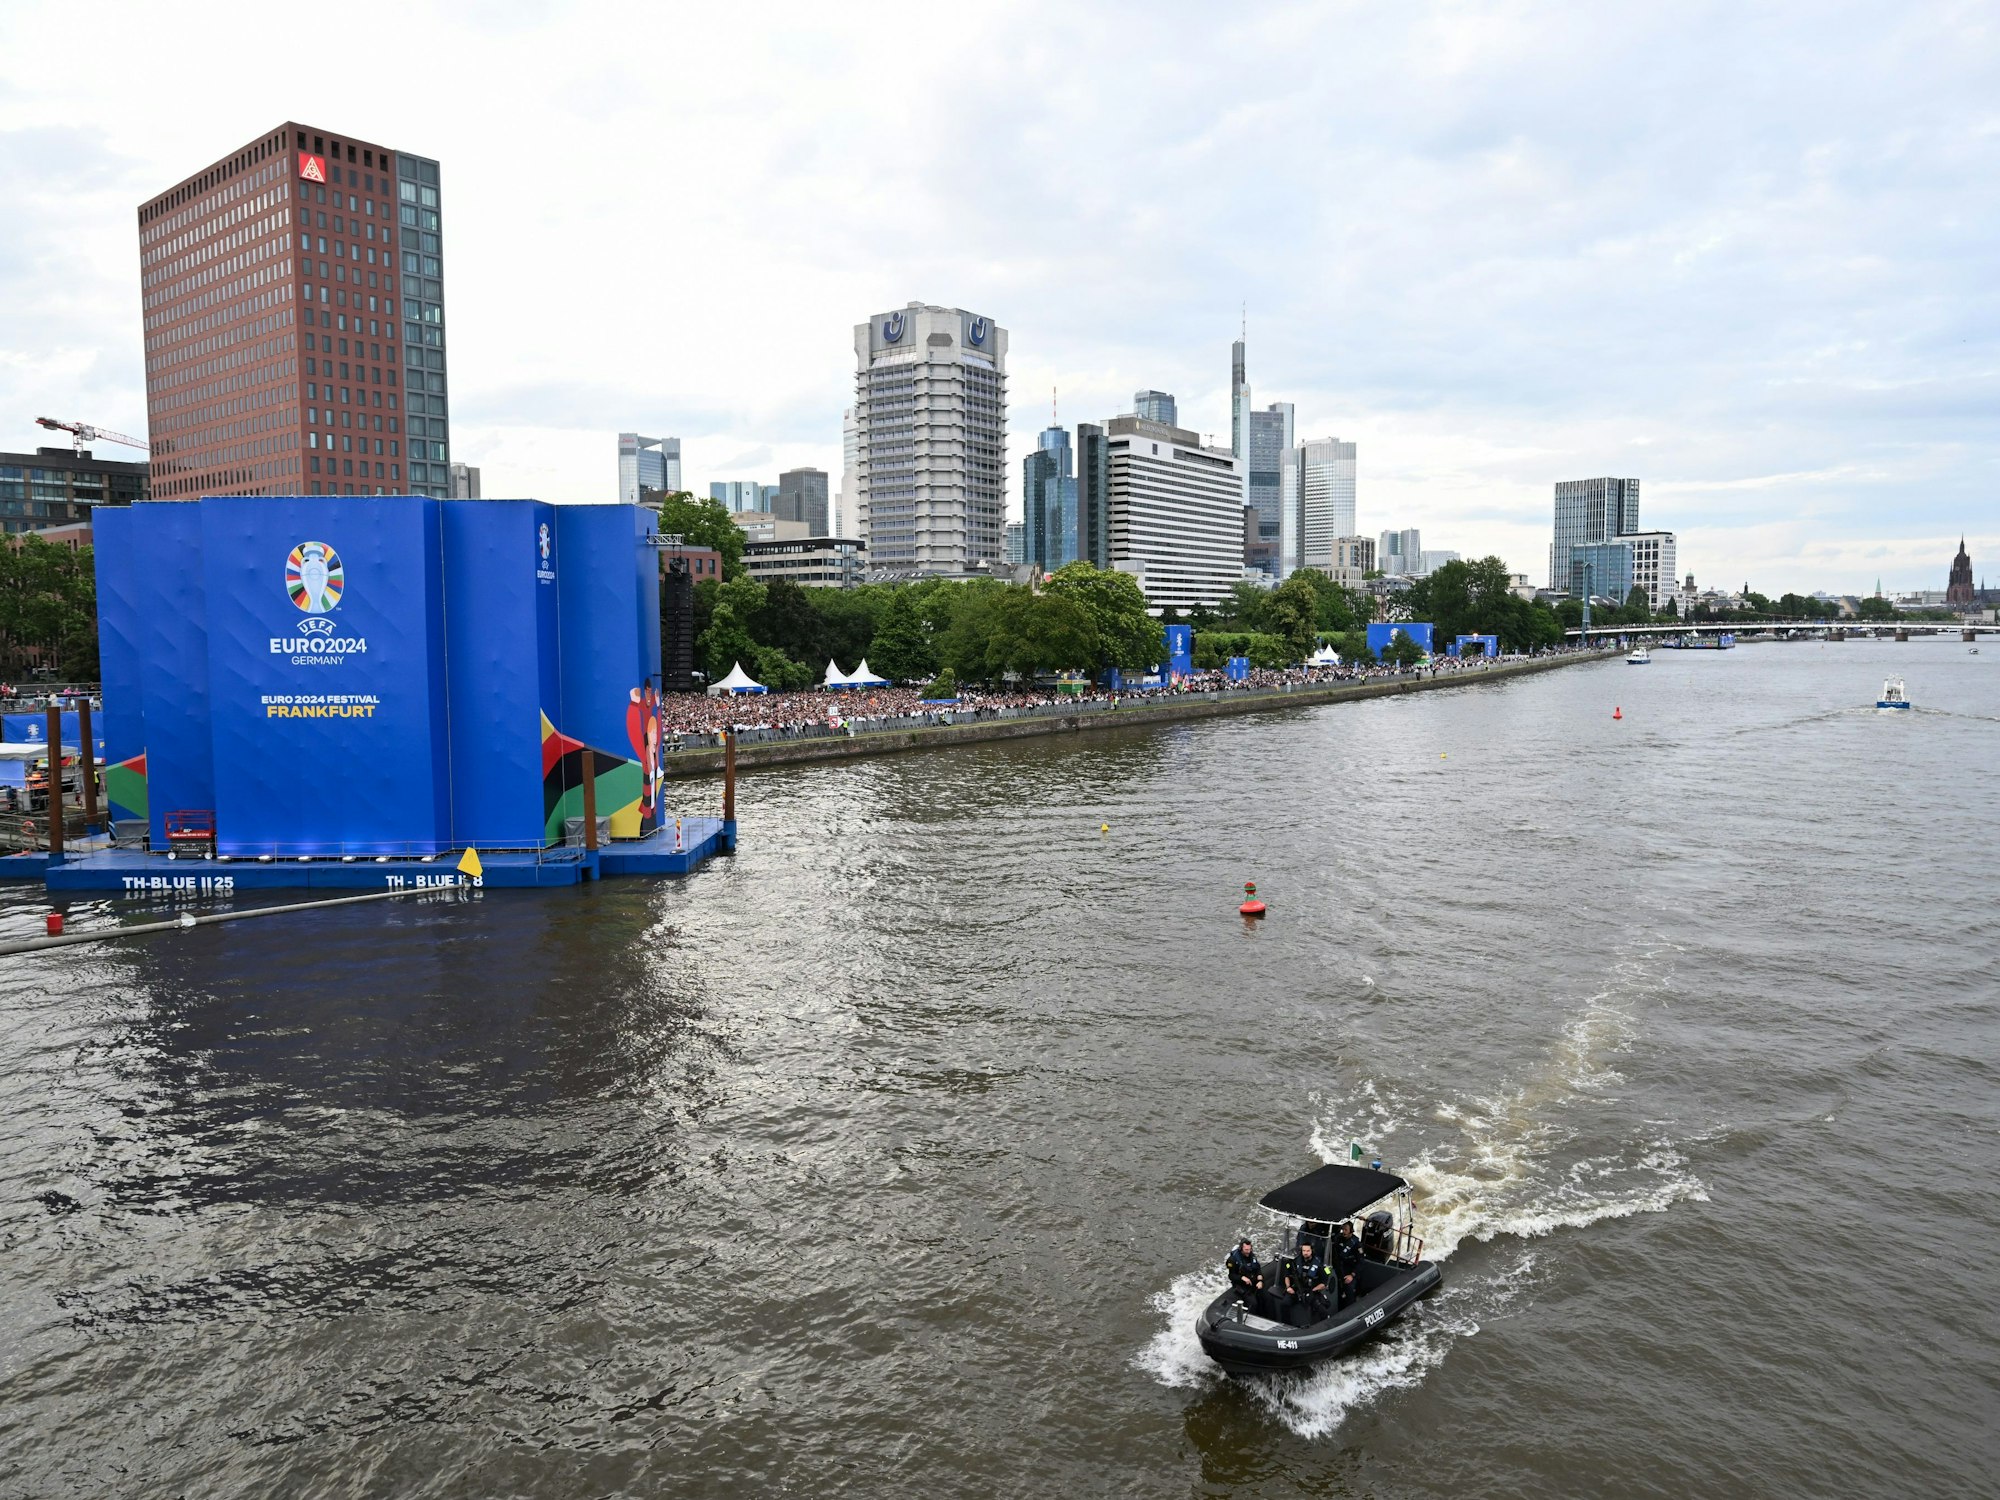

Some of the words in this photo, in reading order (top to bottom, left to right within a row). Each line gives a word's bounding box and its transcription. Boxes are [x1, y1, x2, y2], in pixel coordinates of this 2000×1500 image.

[299, 620, 333, 635] UEFA
[270, 638, 367, 653] EURO2024
[291, 656, 344, 665] GERMANY
[261, 695, 293, 704] EURO
[295, 695, 325, 704] 2024
[327, 695, 380, 704] FESTIVAL
[267, 705, 375, 718] FRANKFURT
[122, 877, 196, 889] TH-BLUE
[214, 876, 234, 889] 25
[386, 876, 404, 887] TH
[416, 875, 454, 887] BLUE
[1277, 1340, 1298, 1350] HE-411
